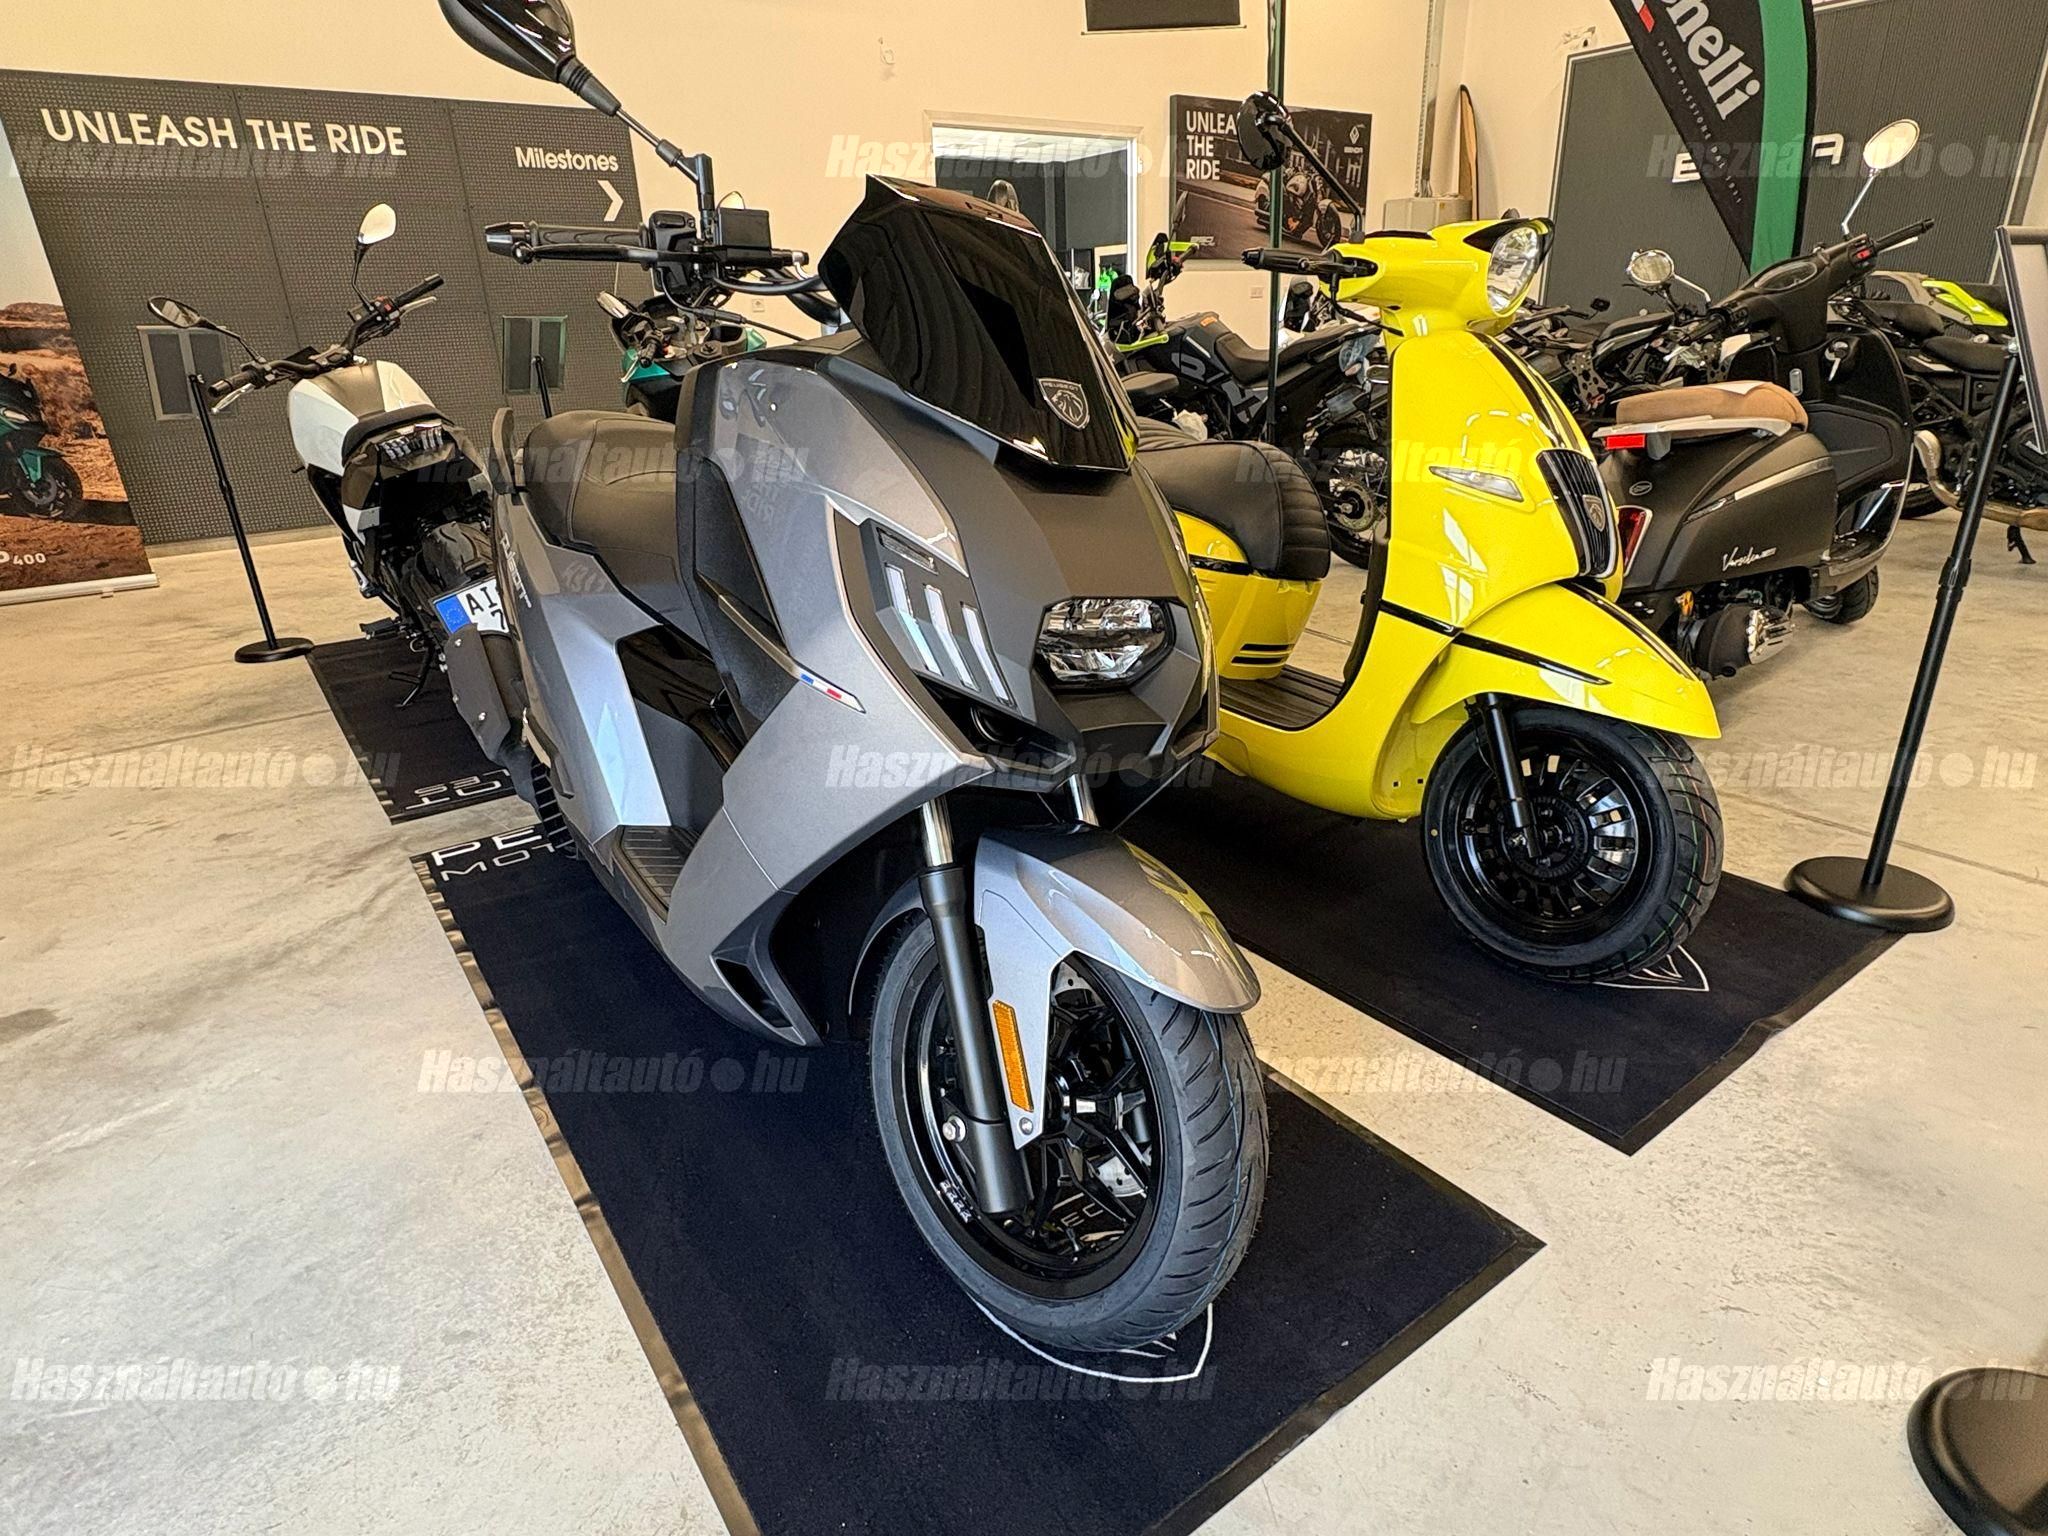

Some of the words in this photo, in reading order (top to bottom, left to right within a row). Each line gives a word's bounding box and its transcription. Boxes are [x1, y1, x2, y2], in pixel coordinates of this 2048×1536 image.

[1661, 0, 1760, 120] nelli
[40, 108, 238, 149] UNLEASH
[245, 119, 317, 152] THE
[324, 123, 408, 156] RIDE
[1186, 110, 1237, 135] UNLEA
[1186, 135, 1214, 157] THE
[514, 146, 619, 172] Milestones
[1186, 159, 1220, 180] RIDE
